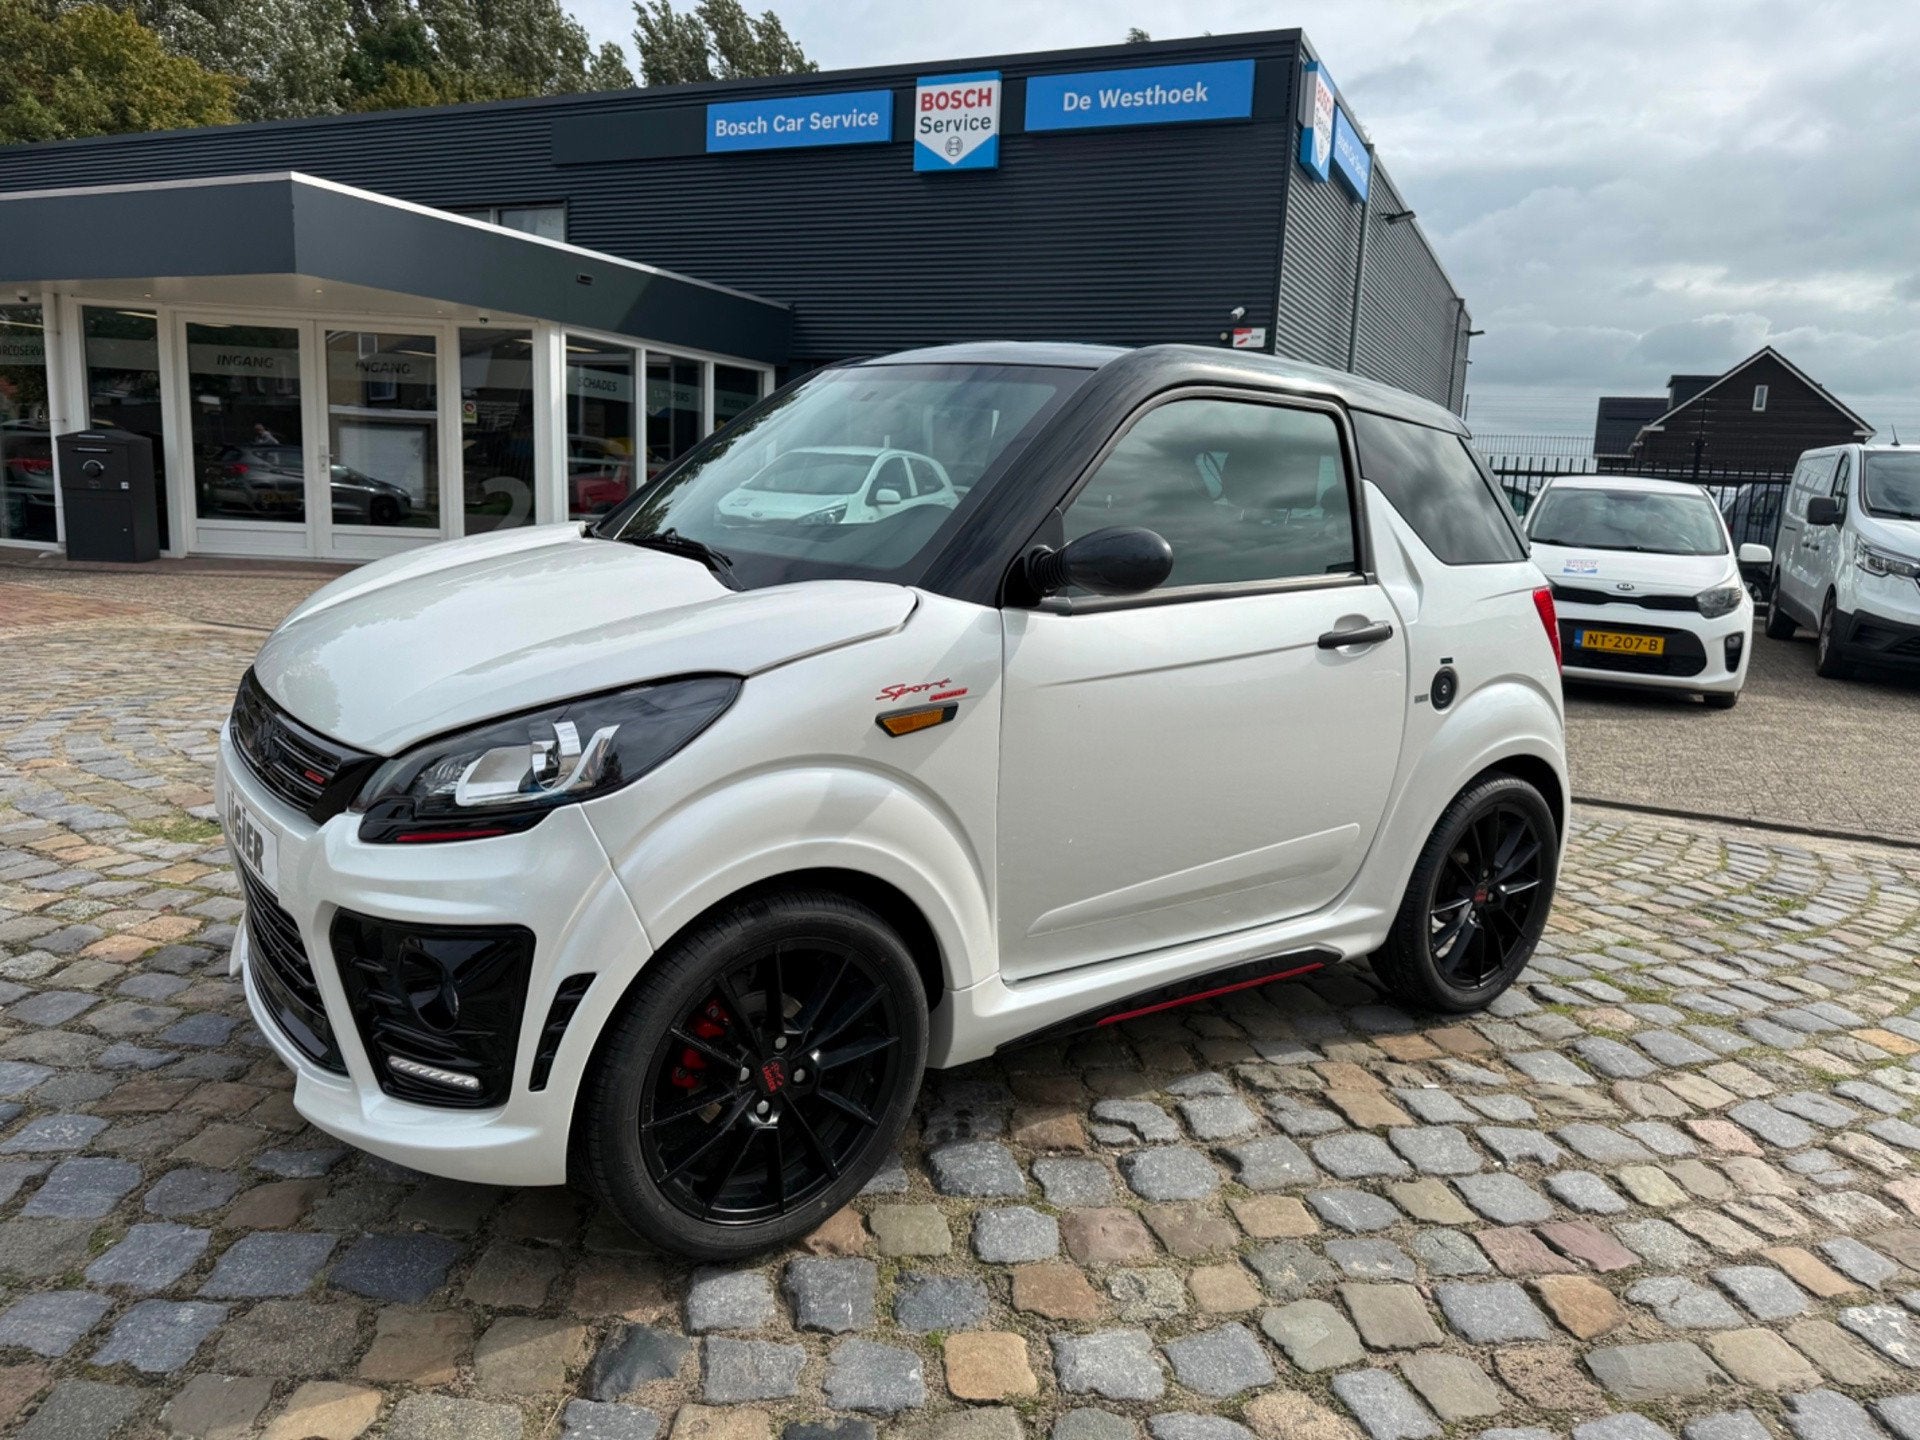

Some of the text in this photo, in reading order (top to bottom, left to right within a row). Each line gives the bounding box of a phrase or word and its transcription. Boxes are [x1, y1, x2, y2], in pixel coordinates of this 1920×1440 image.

[920, 87, 992, 112] BOSCH
[1063, 81, 1209, 112] De Westhoek
[715, 108, 879, 137] Bosch Car Service
[920, 113, 992, 134] Service
[216, 354, 275, 369] INGANG
[355, 360, 411, 374] INGANG
[1587, 633, 1659, 651] NT-207-B
[875, 677, 952, 702] Sport
